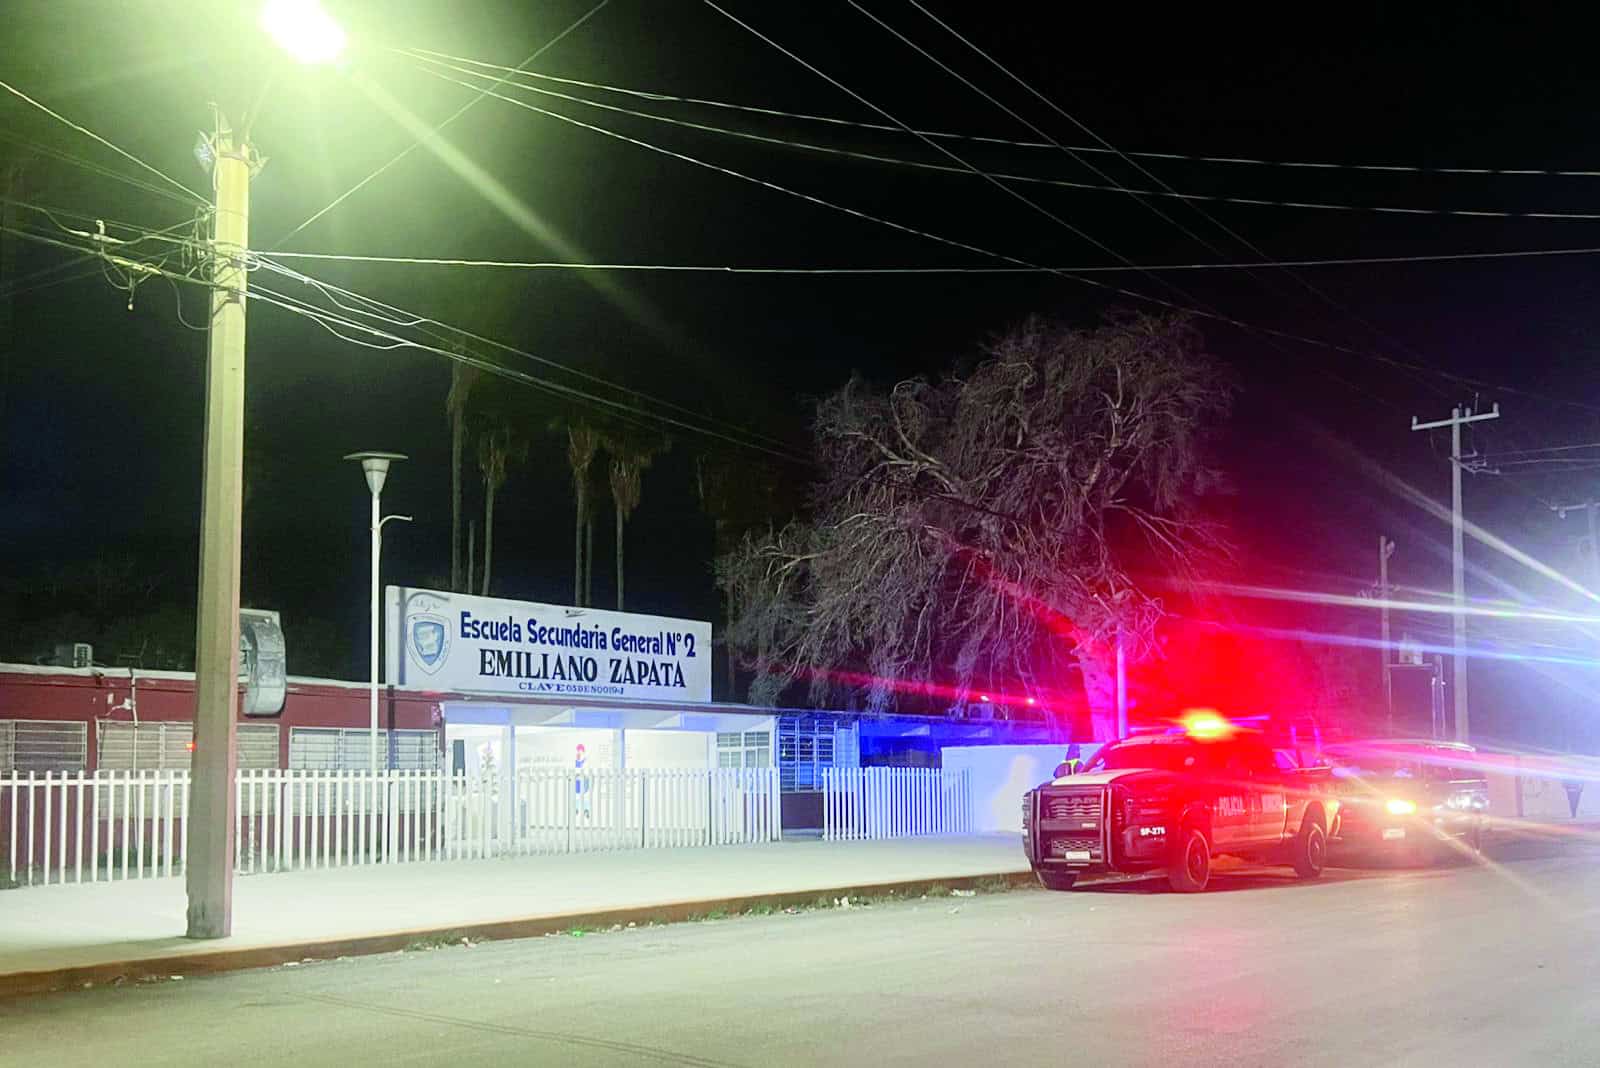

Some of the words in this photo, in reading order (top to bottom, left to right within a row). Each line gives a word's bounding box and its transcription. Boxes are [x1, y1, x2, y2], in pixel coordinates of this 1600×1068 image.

[461, 611, 522, 643] Escuela
[527, 618, 607, 650] Secundaria
[611, 627, 663, 655] General
[684, 633, 696, 658] 2
[479, 648, 598, 682] EMILIANO
[609, 656, 686, 688] ZAPATA
[519, 682, 565, 692] CLAVE
